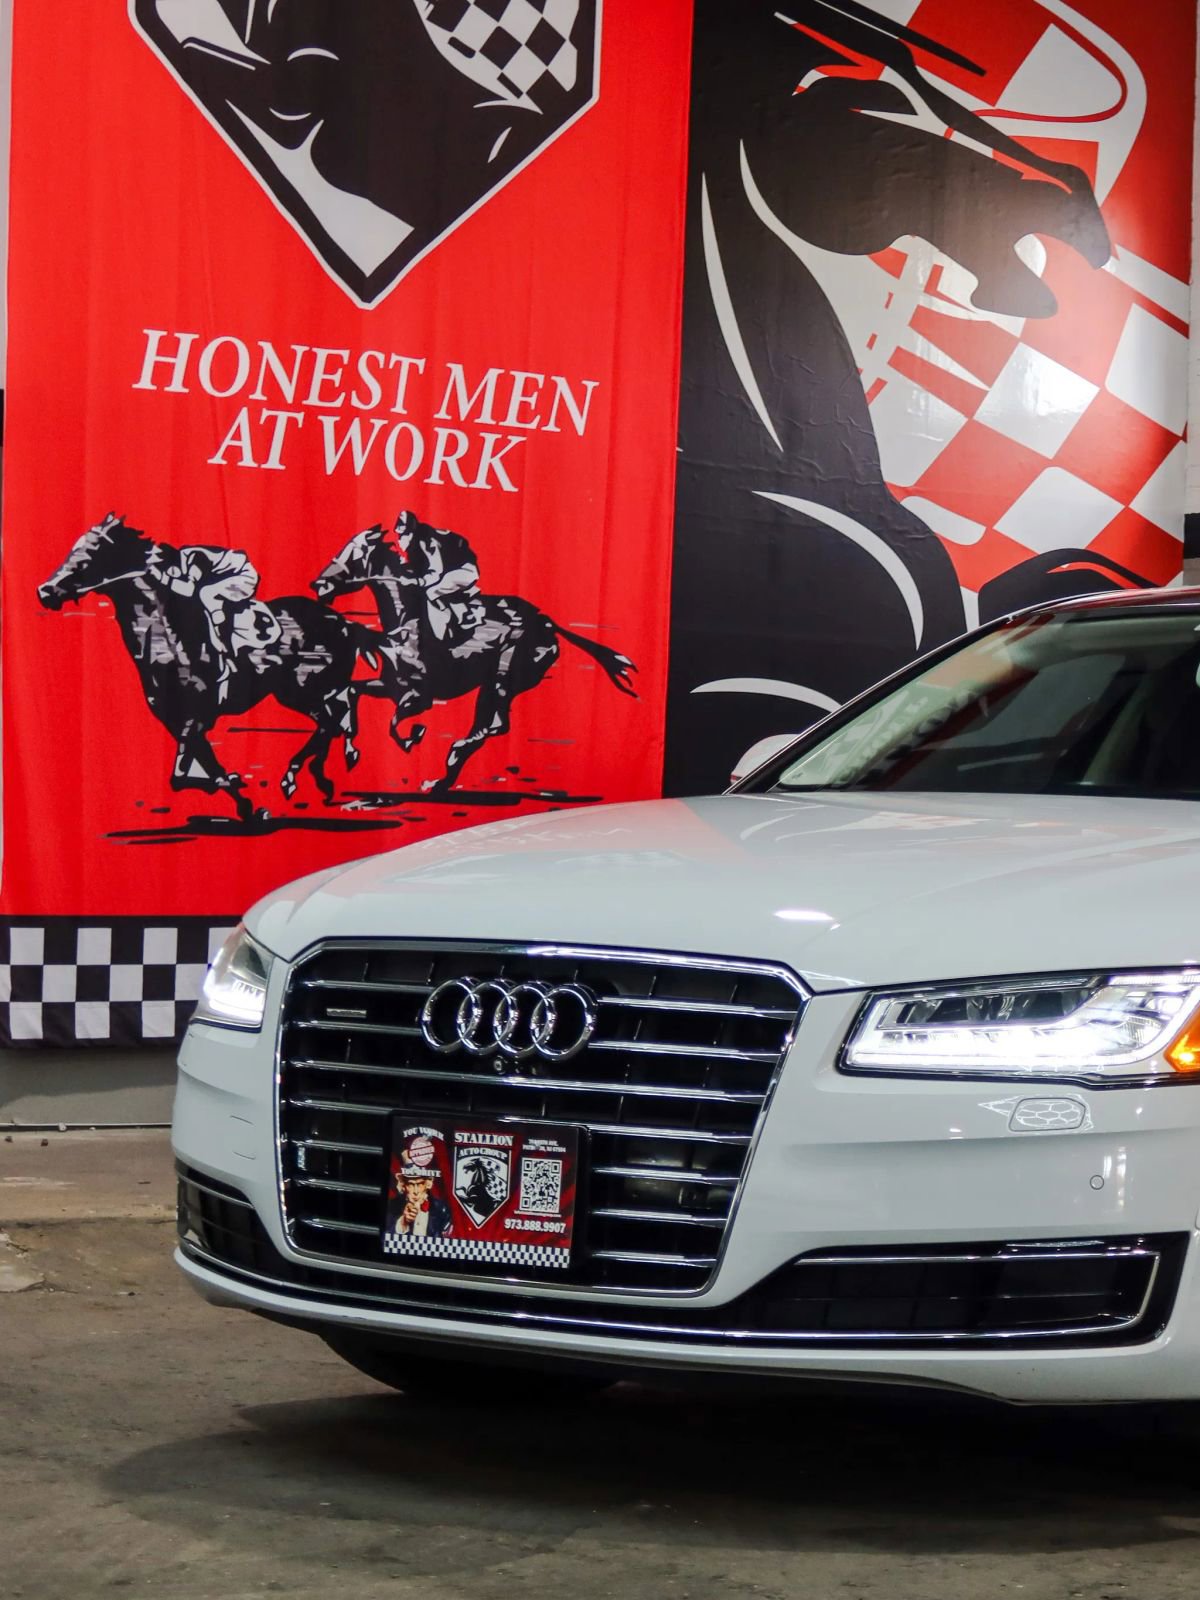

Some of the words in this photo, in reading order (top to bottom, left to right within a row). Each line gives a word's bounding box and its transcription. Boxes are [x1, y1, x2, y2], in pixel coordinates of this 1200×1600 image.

[132, 329, 425, 414] HONEST
[434, 363, 600, 436] MEN
[207, 406, 304, 470] AT
[317, 415, 527, 492] WORK
[454, 1132, 514, 1147] STALLION
[458, 1147, 479, 1158] AUTO
